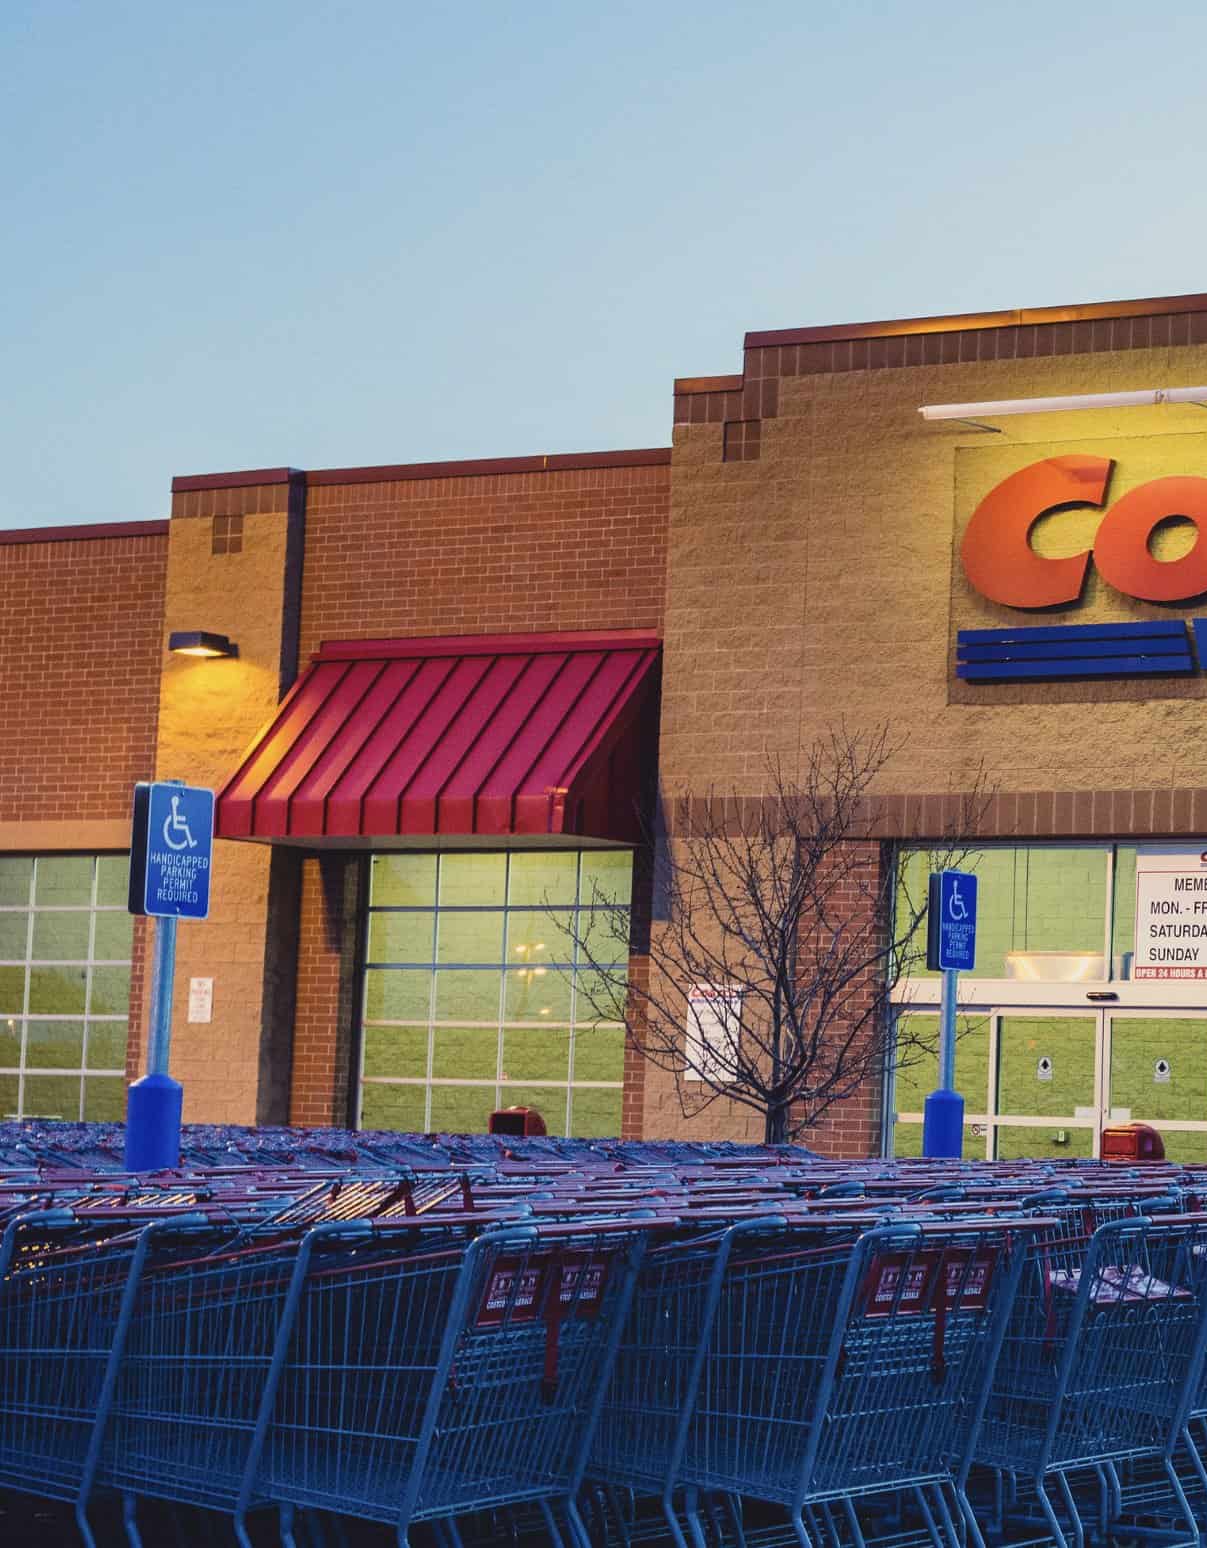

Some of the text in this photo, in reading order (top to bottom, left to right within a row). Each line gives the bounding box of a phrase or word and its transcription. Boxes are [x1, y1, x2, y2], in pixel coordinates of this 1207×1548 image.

[150, 852, 208, 869] HANDICAPPED
[161, 865, 196, 880] PARKING
[164, 877, 193, 891] PERMIT
[157, 888, 198, 904] REQUIRED
[1150, 901, 1182, 914] MON.
[1149, 948, 1199, 960] SUNDAY
[1135, 969, 1156, 977] OPEN
[1158, 969, 1169, 977] 24
[1170, 969, 1196, 978] HOURS
[1197, 970, 1203, 978] A
